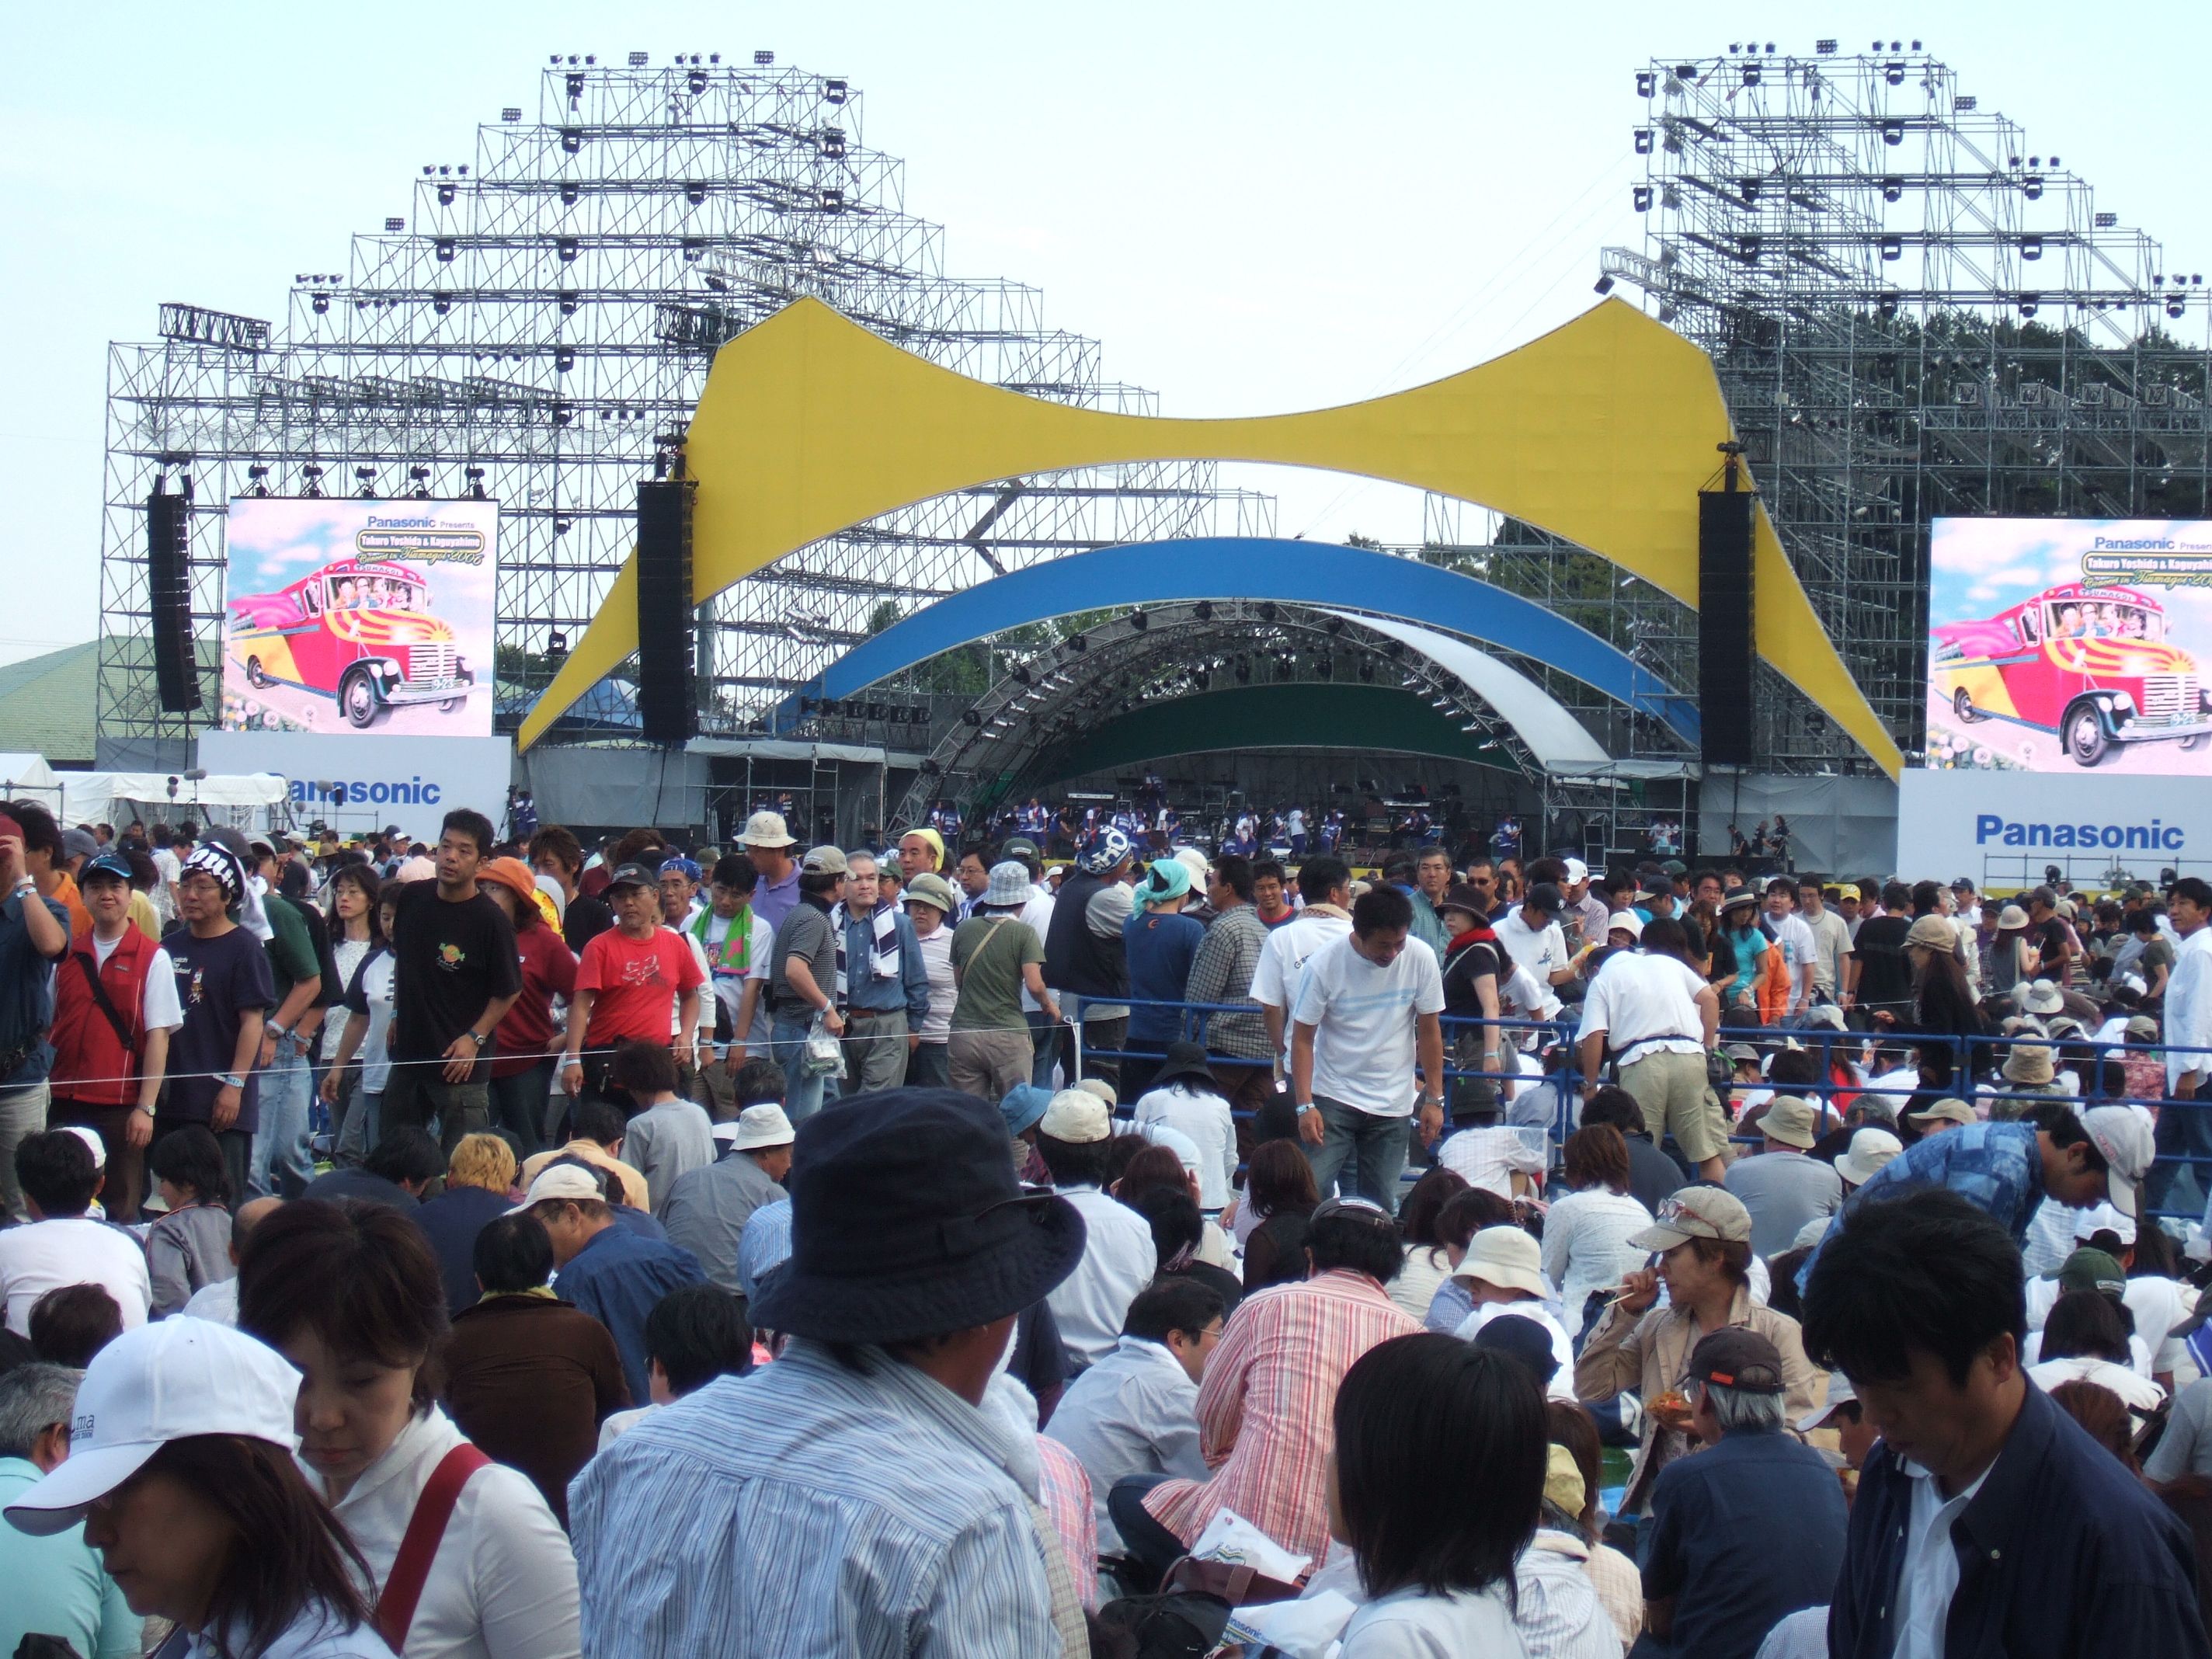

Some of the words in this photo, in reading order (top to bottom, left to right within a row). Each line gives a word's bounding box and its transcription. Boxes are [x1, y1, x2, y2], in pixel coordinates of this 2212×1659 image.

[367, 516, 436, 528] Panasonic
[390, 536, 422, 547] Yoshida
[2095, 537, 2175, 550] Panasonic
[450, 548, 485, 566] 2006
[2088, 558, 2120, 569] Takuro
[2120, 558, 2158, 569] Yoshida
[269, 772, 440, 805] anasonic
[1976, 814, 2185, 850] Panasonic
